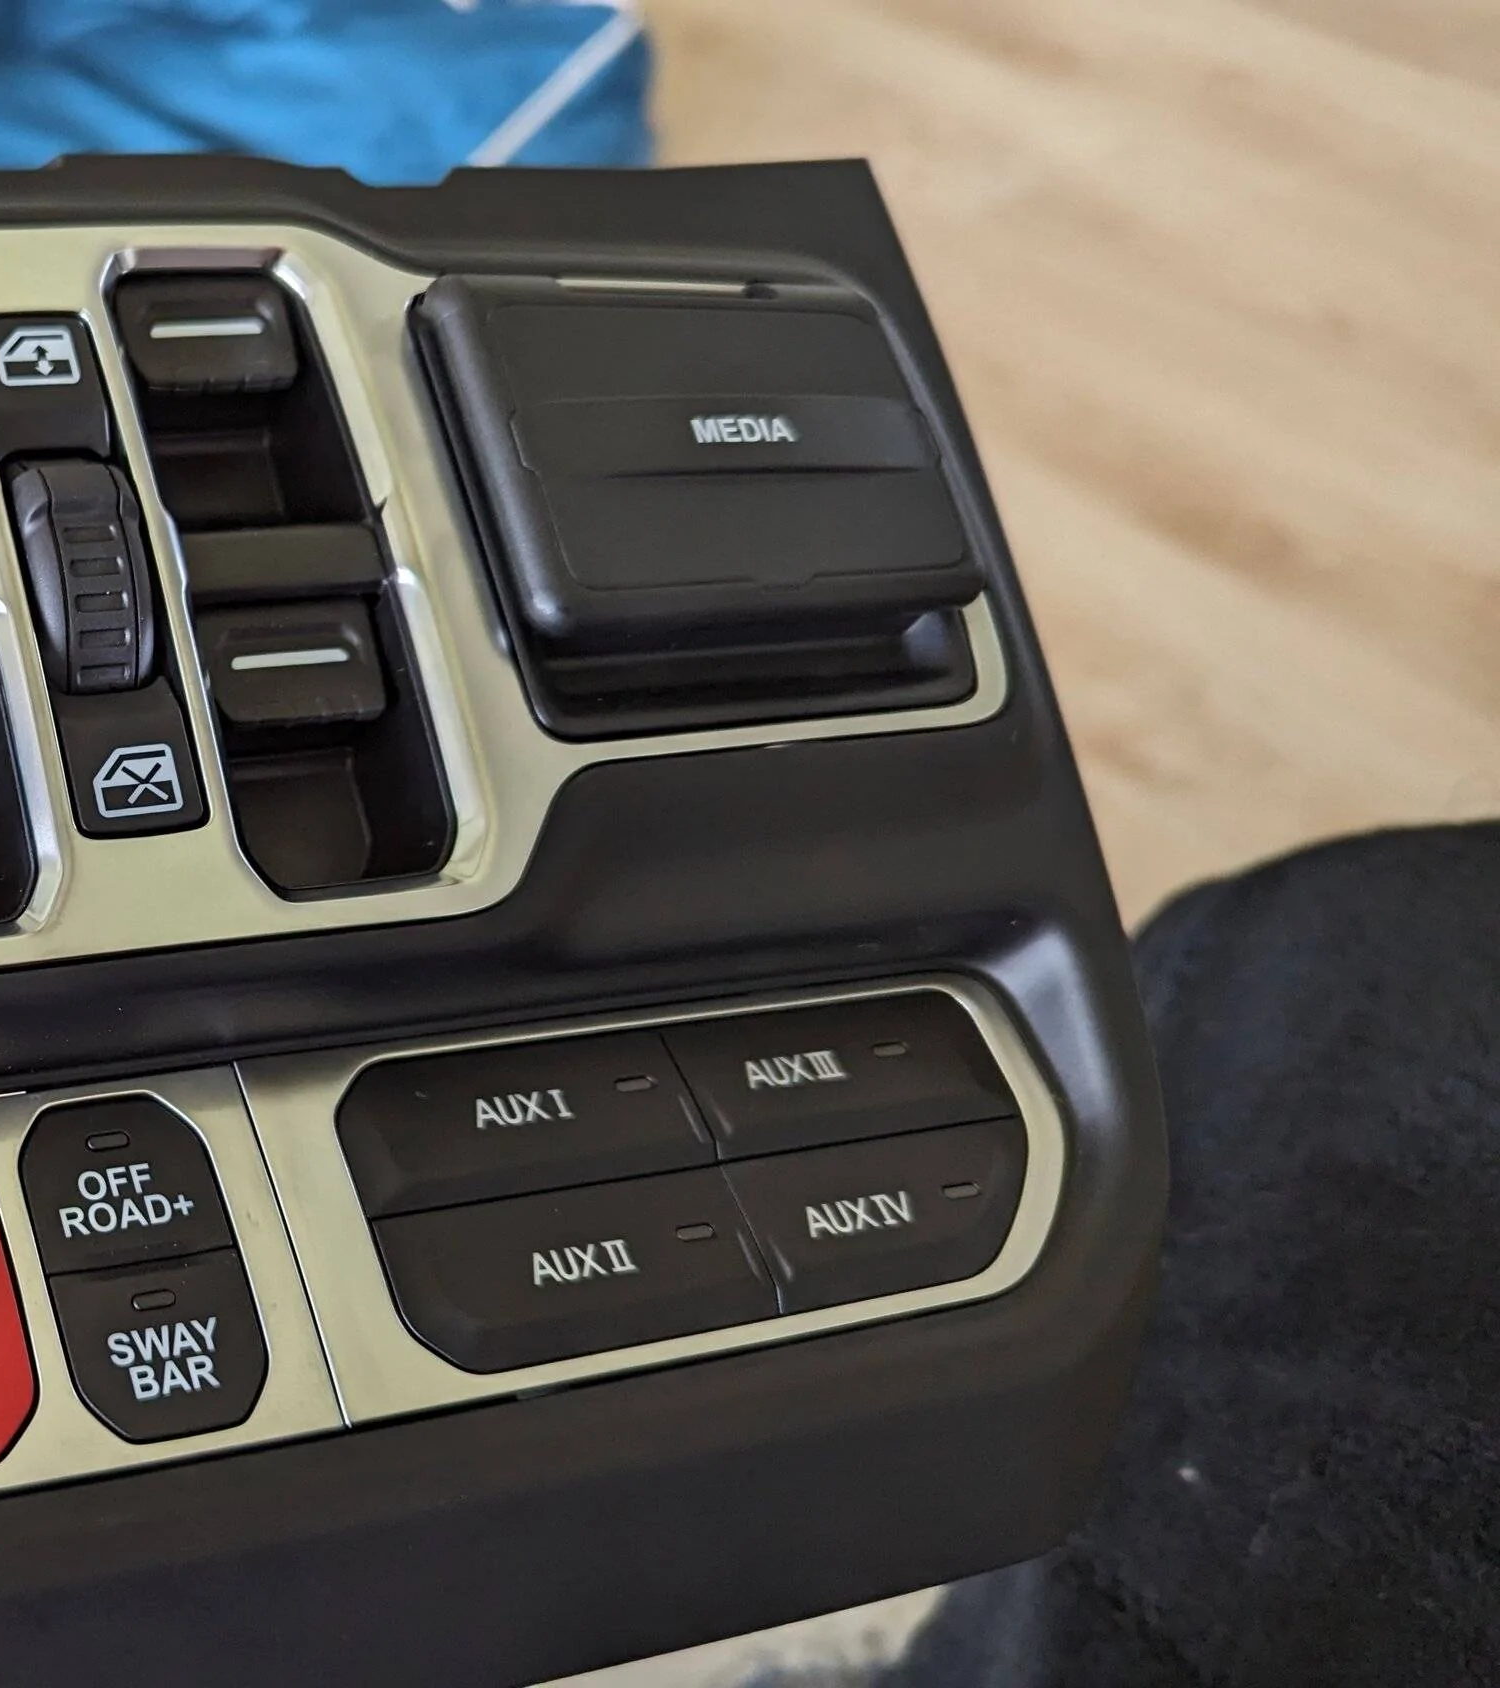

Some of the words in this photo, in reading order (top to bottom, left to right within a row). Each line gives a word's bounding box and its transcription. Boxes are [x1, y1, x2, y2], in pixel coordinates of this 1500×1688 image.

[690, 416, 798, 444] MEDIA
[476, 1090, 553, 1130] AUX
[77, 1162, 151, 1201] OFF
[58, 1193, 195, 1239] ROAD+
[532, 1243, 609, 1287] AUX
[107, 1316, 218, 1368] SWAY
[129, 1354, 221, 1402] BAR
